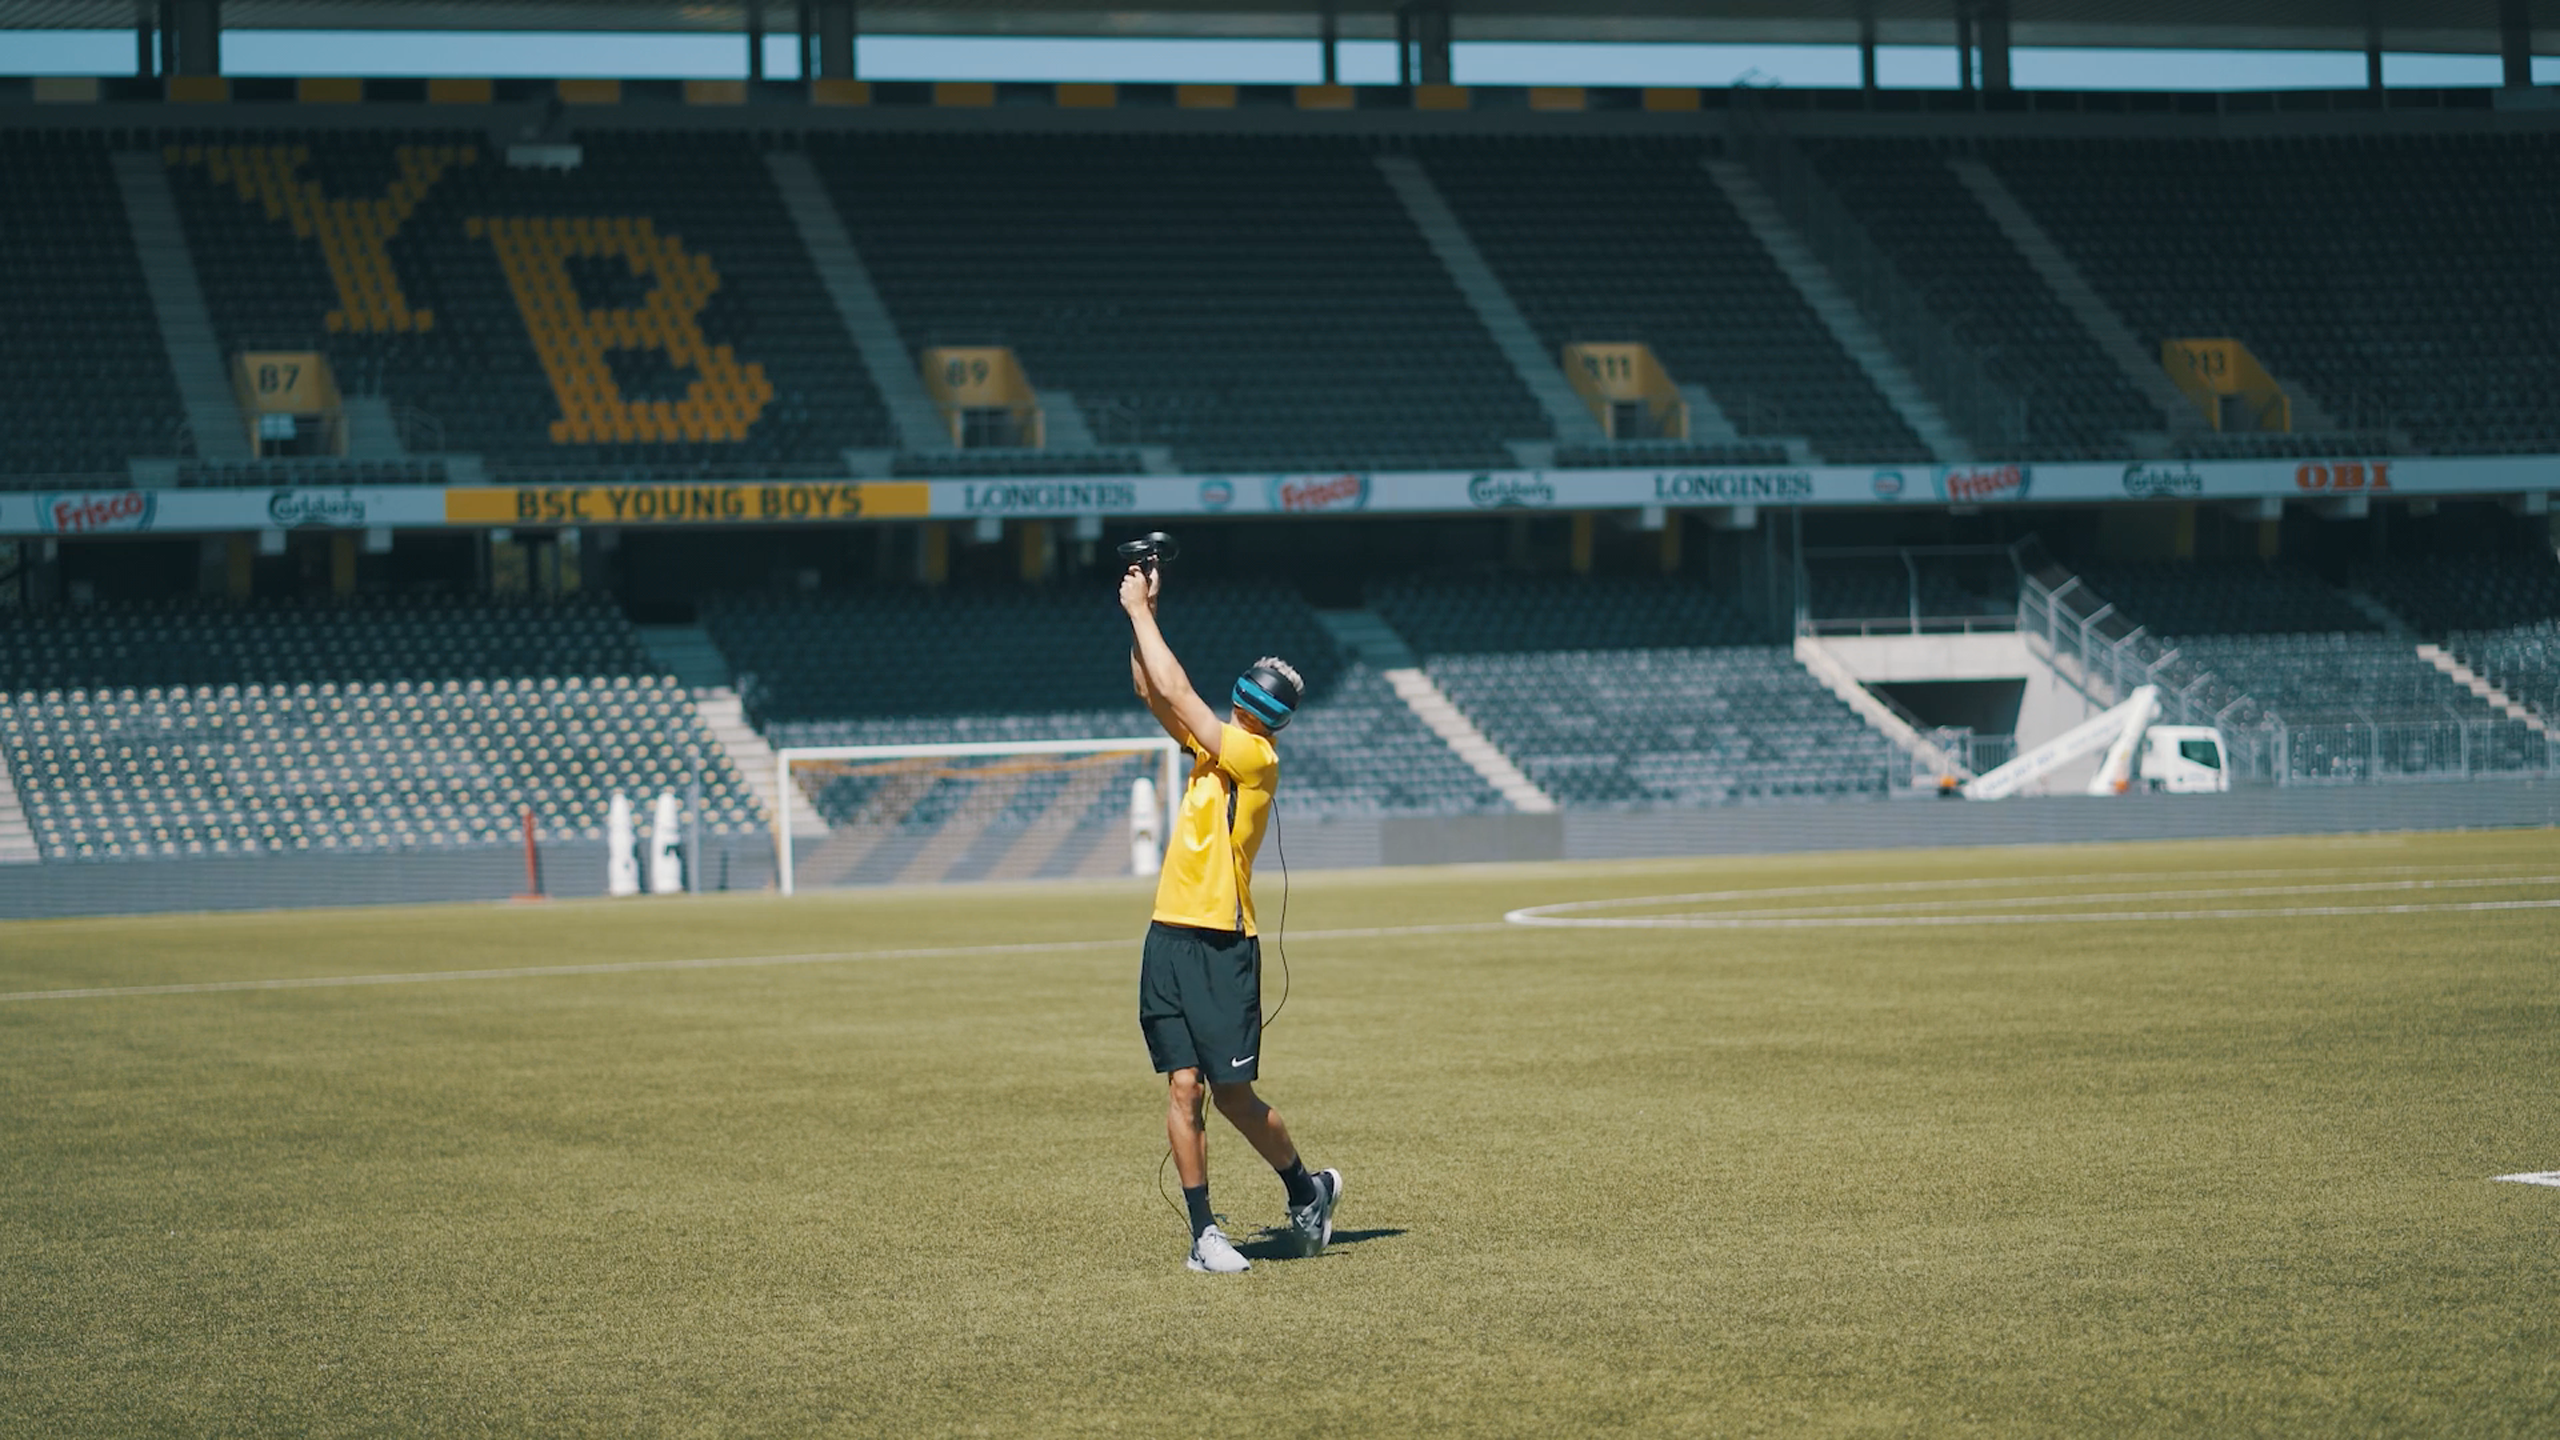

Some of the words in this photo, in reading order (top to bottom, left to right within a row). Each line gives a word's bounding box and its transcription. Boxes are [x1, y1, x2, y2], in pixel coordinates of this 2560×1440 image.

[1655, 472, 1814, 500] LONGINES
[2294, 461, 2392, 494] OBI
[55, 491, 144, 534] Frisco
[516, 488, 593, 519] BSC
[606, 486, 744, 518] YOUNG
[758, 484, 863, 517] BOYS
[963, 482, 1136, 510] LONGINES
